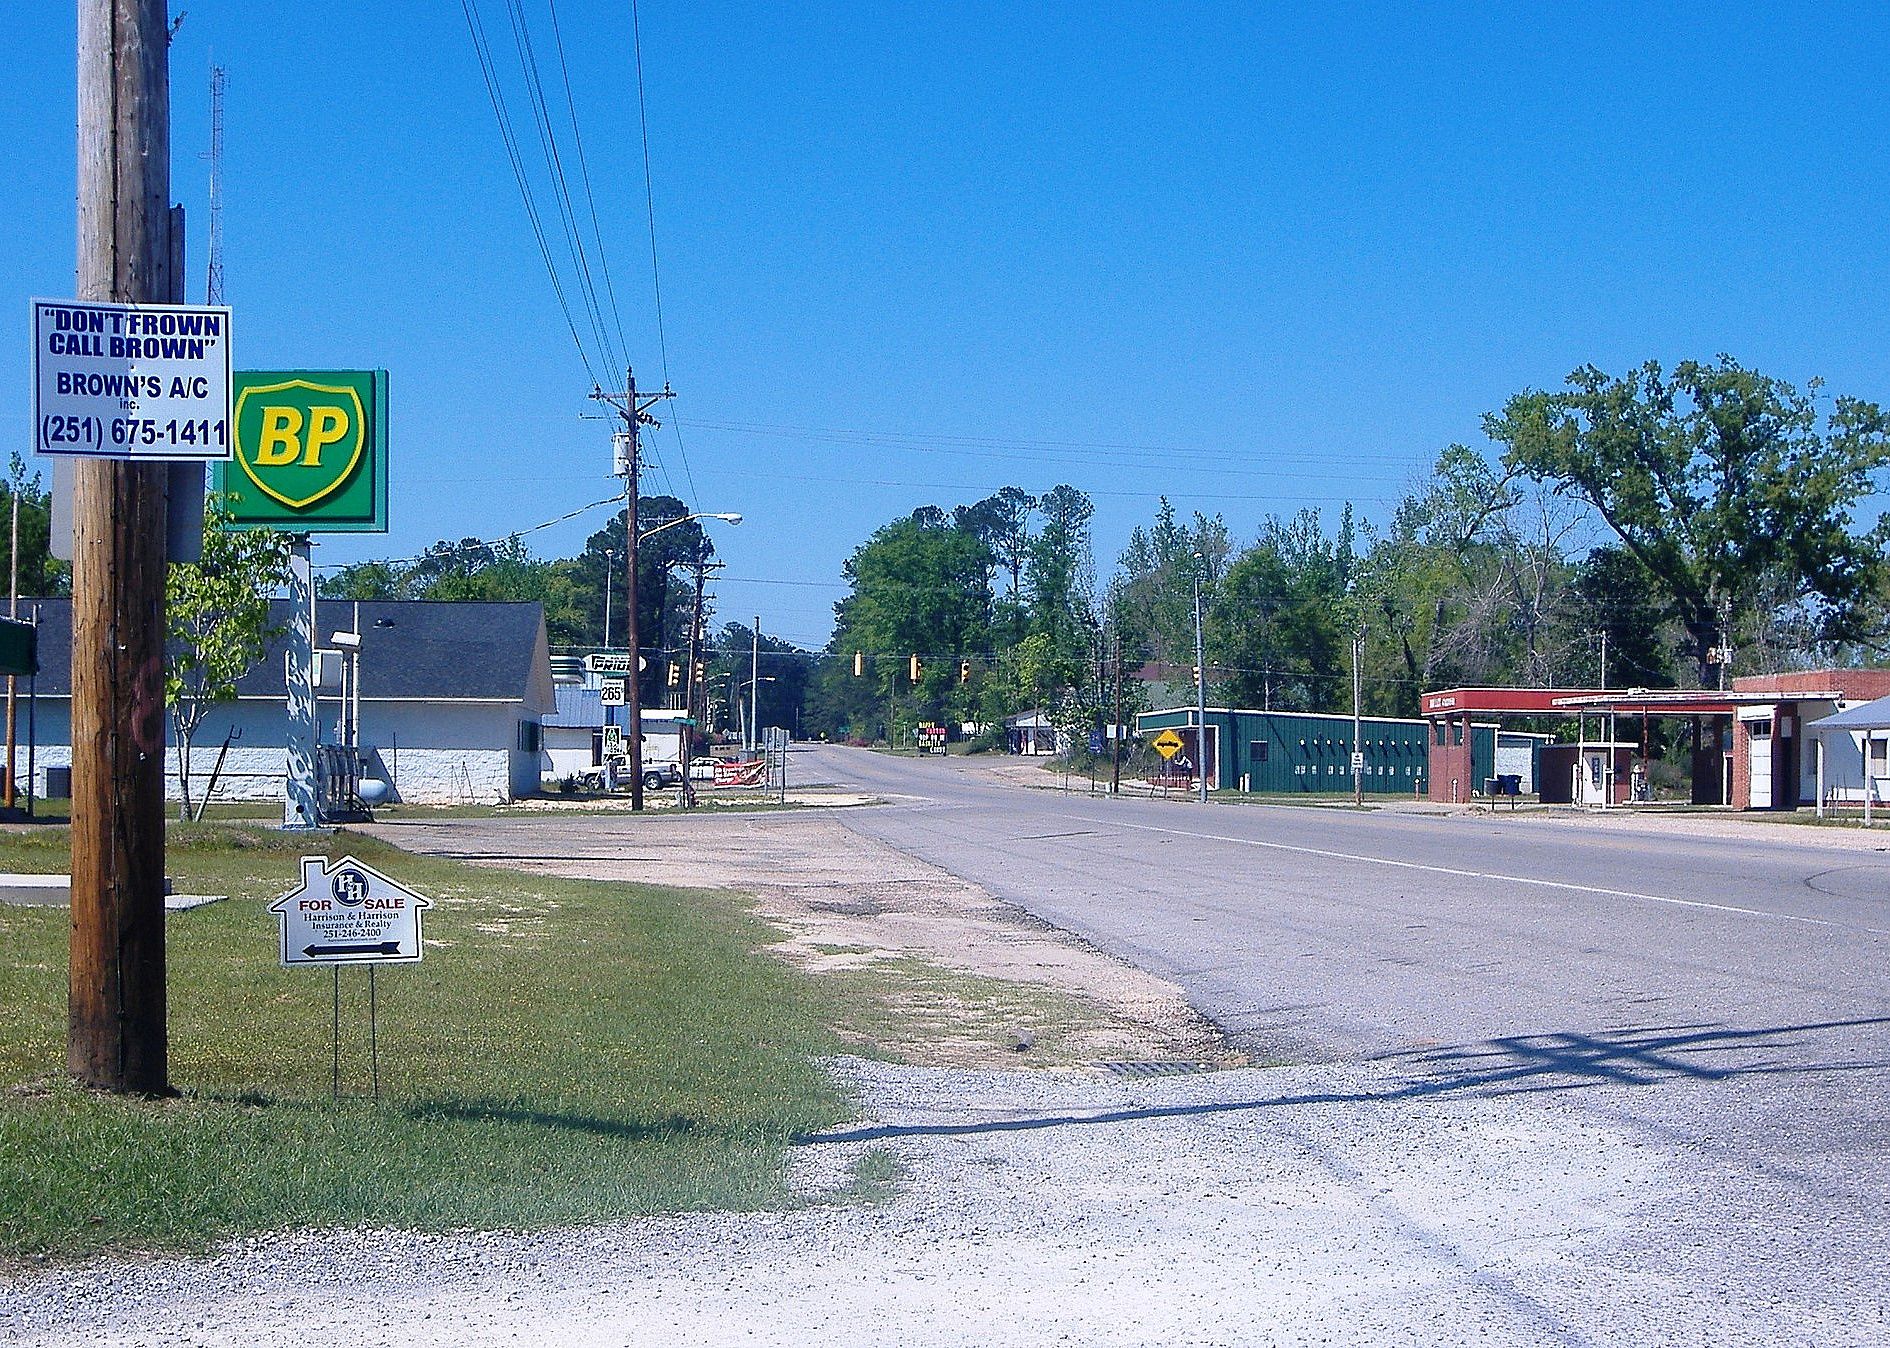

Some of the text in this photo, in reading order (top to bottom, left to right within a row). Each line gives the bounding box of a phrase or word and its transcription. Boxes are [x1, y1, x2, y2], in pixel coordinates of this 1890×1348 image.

[44, 308, 220, 337] "DON'T FROWN
[49, 333, 217, 360] CALL BROWN"
[57, 372, 209, 399] BROWN'S A/C
[119, 397, 140, 410] inc.
[42, 414, 225, 450] (251) 675-1411
[252, 405, 350, 466] BP
[602, 687, 621, 701] 265
[299, 898, 405, 911] FOR SALE
[304, 911, 399, 922] Harrison & Harrison
[312, 921, 354, 930] Insurance
[364, 919, 392, 929] Realty
[323, 929, 381, 938] 251-246-2400
